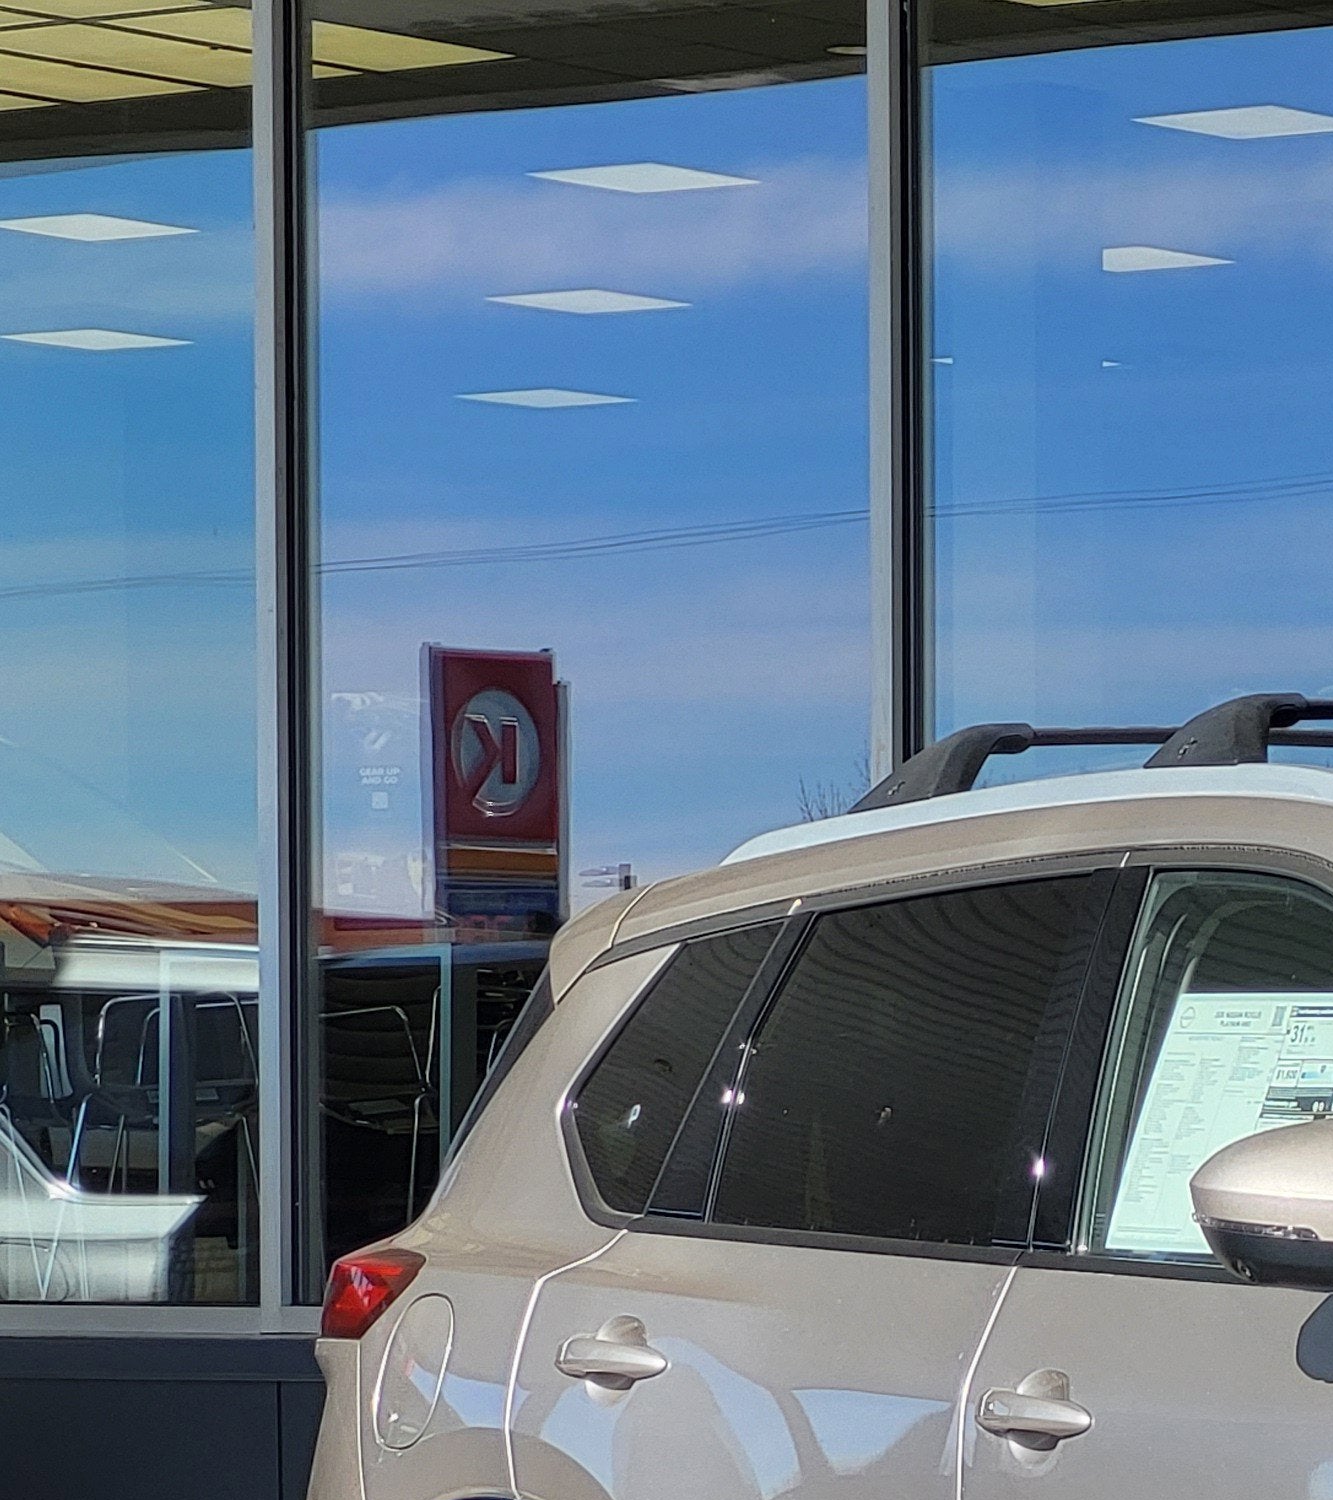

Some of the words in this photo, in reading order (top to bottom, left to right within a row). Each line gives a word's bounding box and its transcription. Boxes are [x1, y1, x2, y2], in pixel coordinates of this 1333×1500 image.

[386, 767, 400, 776] UP
[361, 776, 382, 785] AND
[384, 776, 399, 785] GO
